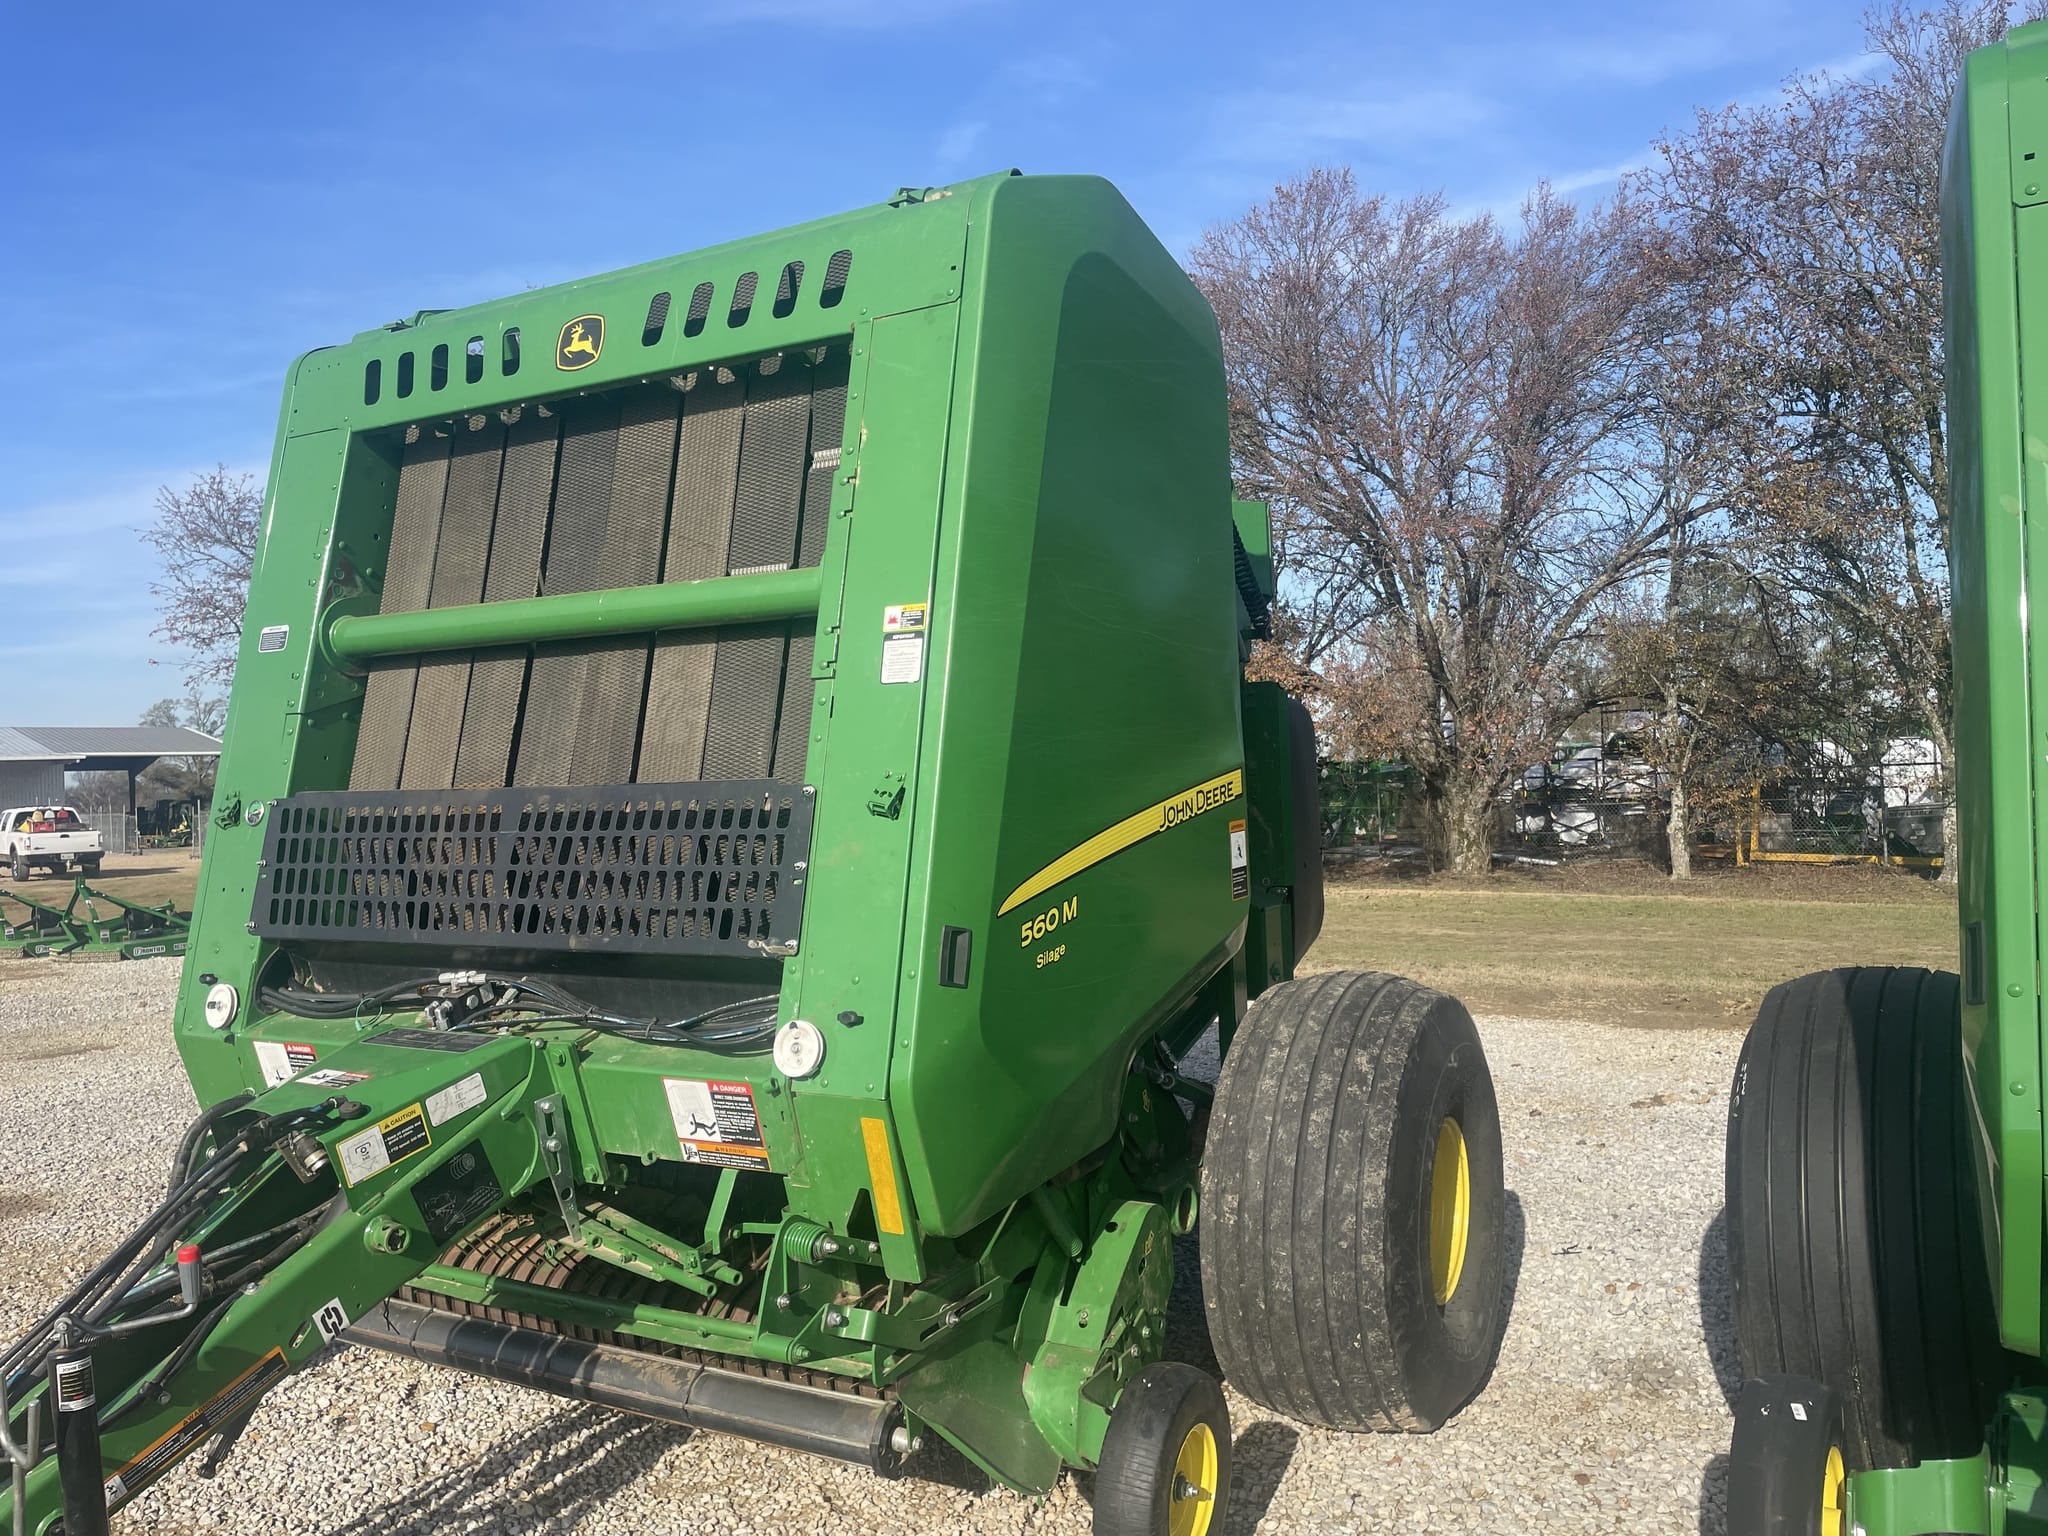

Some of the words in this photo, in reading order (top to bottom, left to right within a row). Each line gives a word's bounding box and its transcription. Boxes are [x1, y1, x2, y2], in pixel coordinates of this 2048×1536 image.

[1160, 797, 1195, 830] JOHN
[1196, 781, 1234, 812] DEERE
[1021, 907, 1060, 949] 560
[1063, 895, 1078, 924] M
[1036, 943, 1066, 969] Silage
[719, 1084, 747, 1094] DANGER
[390, 1108, 416, 1126] CAUTION
[719, 1146, 748, 1155] WARNING
